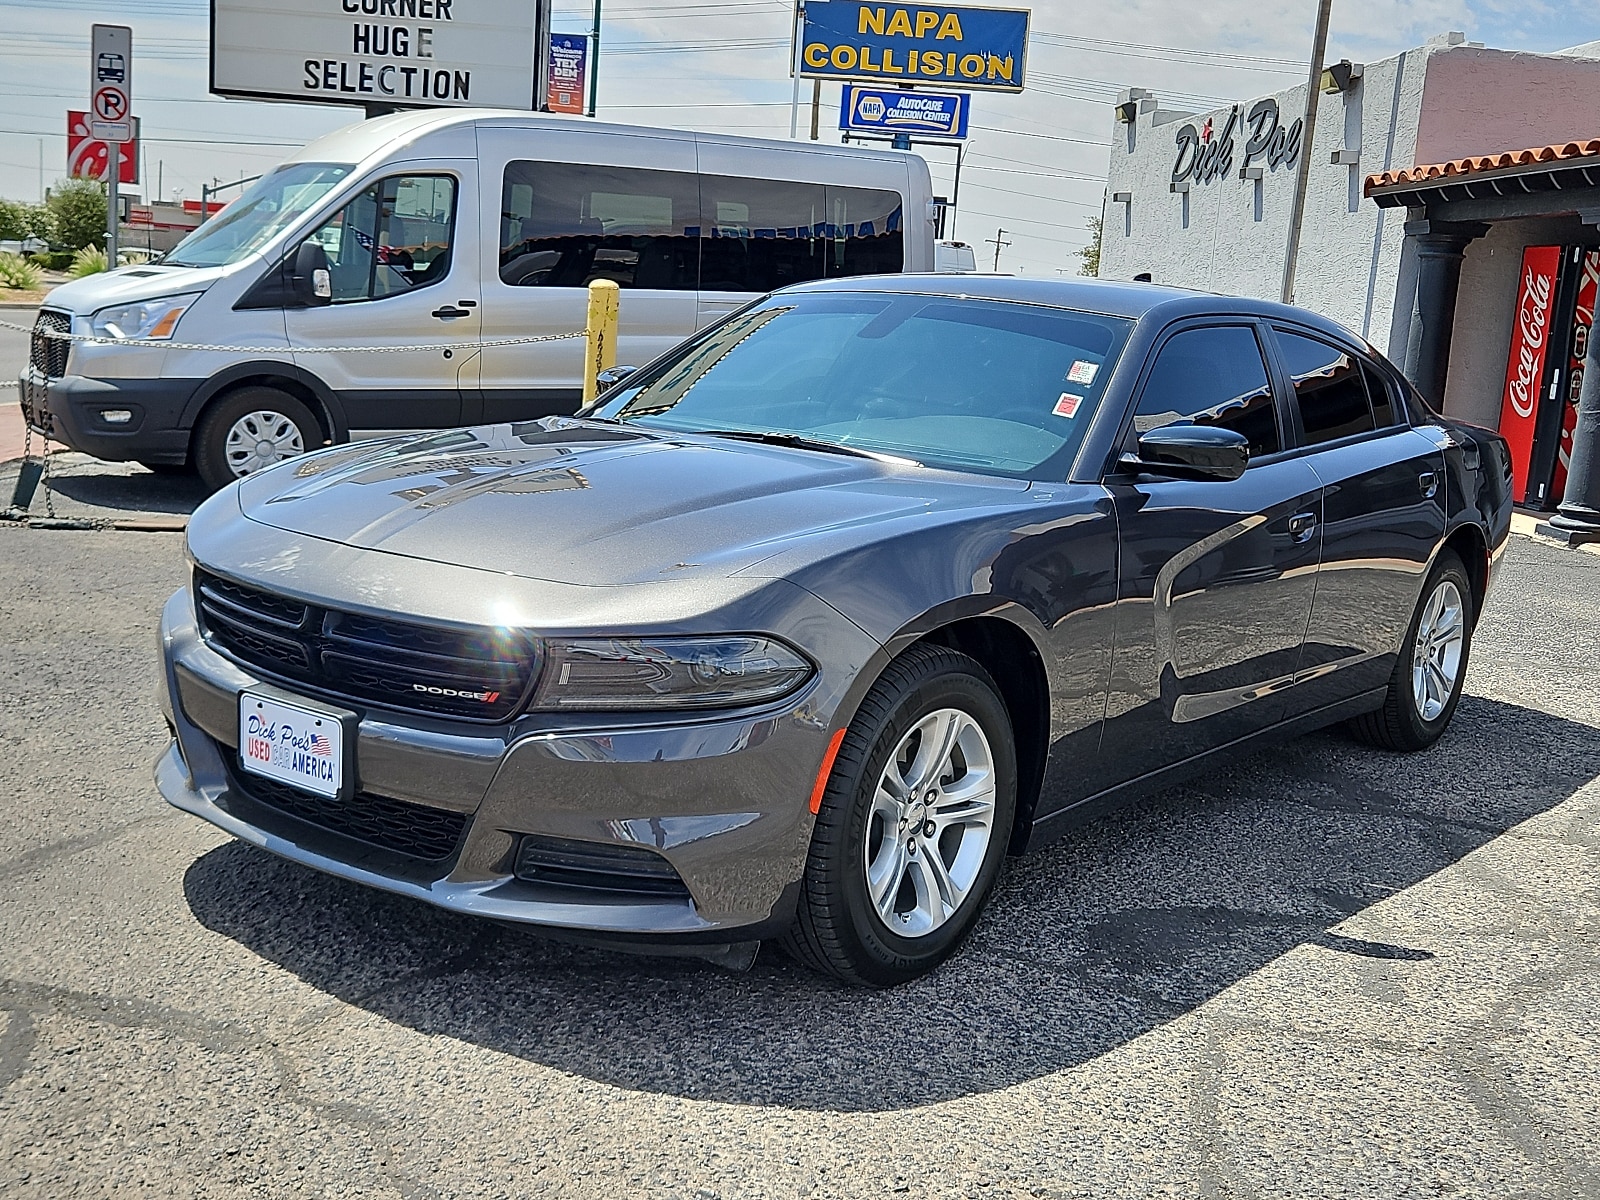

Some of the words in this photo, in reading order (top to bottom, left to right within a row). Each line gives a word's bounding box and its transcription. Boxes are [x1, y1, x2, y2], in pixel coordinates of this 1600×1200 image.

[353, 23, 433, 58] HUGE
[858, 6, 963, 41] NAPA
[554, 67, 578, 78] DEM
[555, 58, 580, 69] TEX
[804, 42, 1014, 80] COLLISION
[303, 59, 470, 100] SELECTION
[862, 102, 881, 115] NAPA
[886, 107, 923, 120] COLLISION
[922, 110, 951, 122] CENTER
[1171, 103, 1235, 182] Dick
[1243, 98, 1303, 168] Poe
[1510, 265, 1550, 418] Coca-Cola
[412, 683, 488, 701] DODGE
[248, 713, 277, 742] Dick
[281, 725, 312, 752] Poe's
[248, 738, 271, 762] USED
[272, 744, 291, 770] CAR
[291, 752, 334, 782] AMERICA
